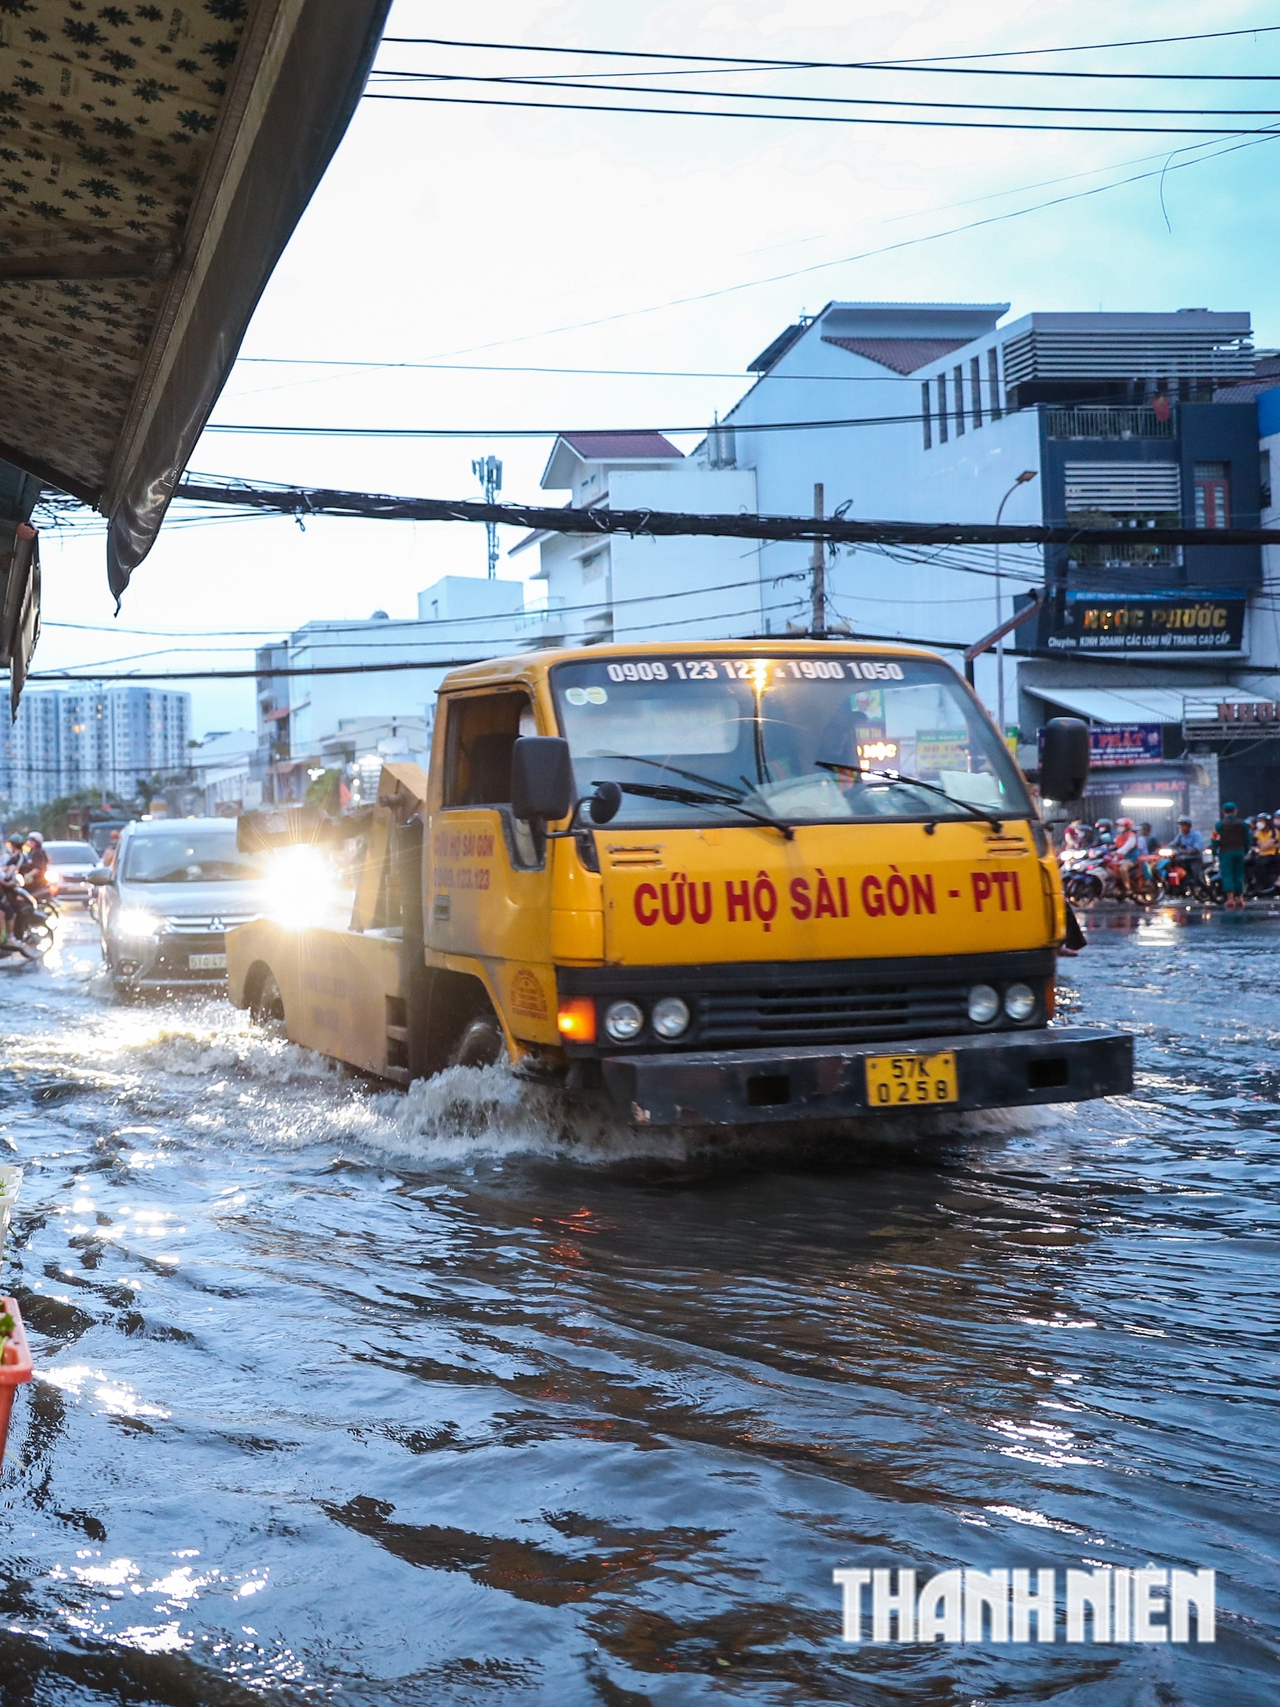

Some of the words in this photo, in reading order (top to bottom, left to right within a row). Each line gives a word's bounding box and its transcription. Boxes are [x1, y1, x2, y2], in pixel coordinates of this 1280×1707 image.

[606, 661, 669, 682] 0909
[672, 660, 719, 680] 123
[787, 661, 846, 680] 1900
[847, 662, 906, 681] 1050
[633, 870, 713, 926] CỨU
[725, 870, 779, 933] HỘ
[790, 867, 850, 921] SÀI
[860, 864, 937, 918] GÒN
[970, 871, 1023, 912] PTI
[891, 1058, 931, 1079] 57K
[877, 1079, 949, 1104] 0258
